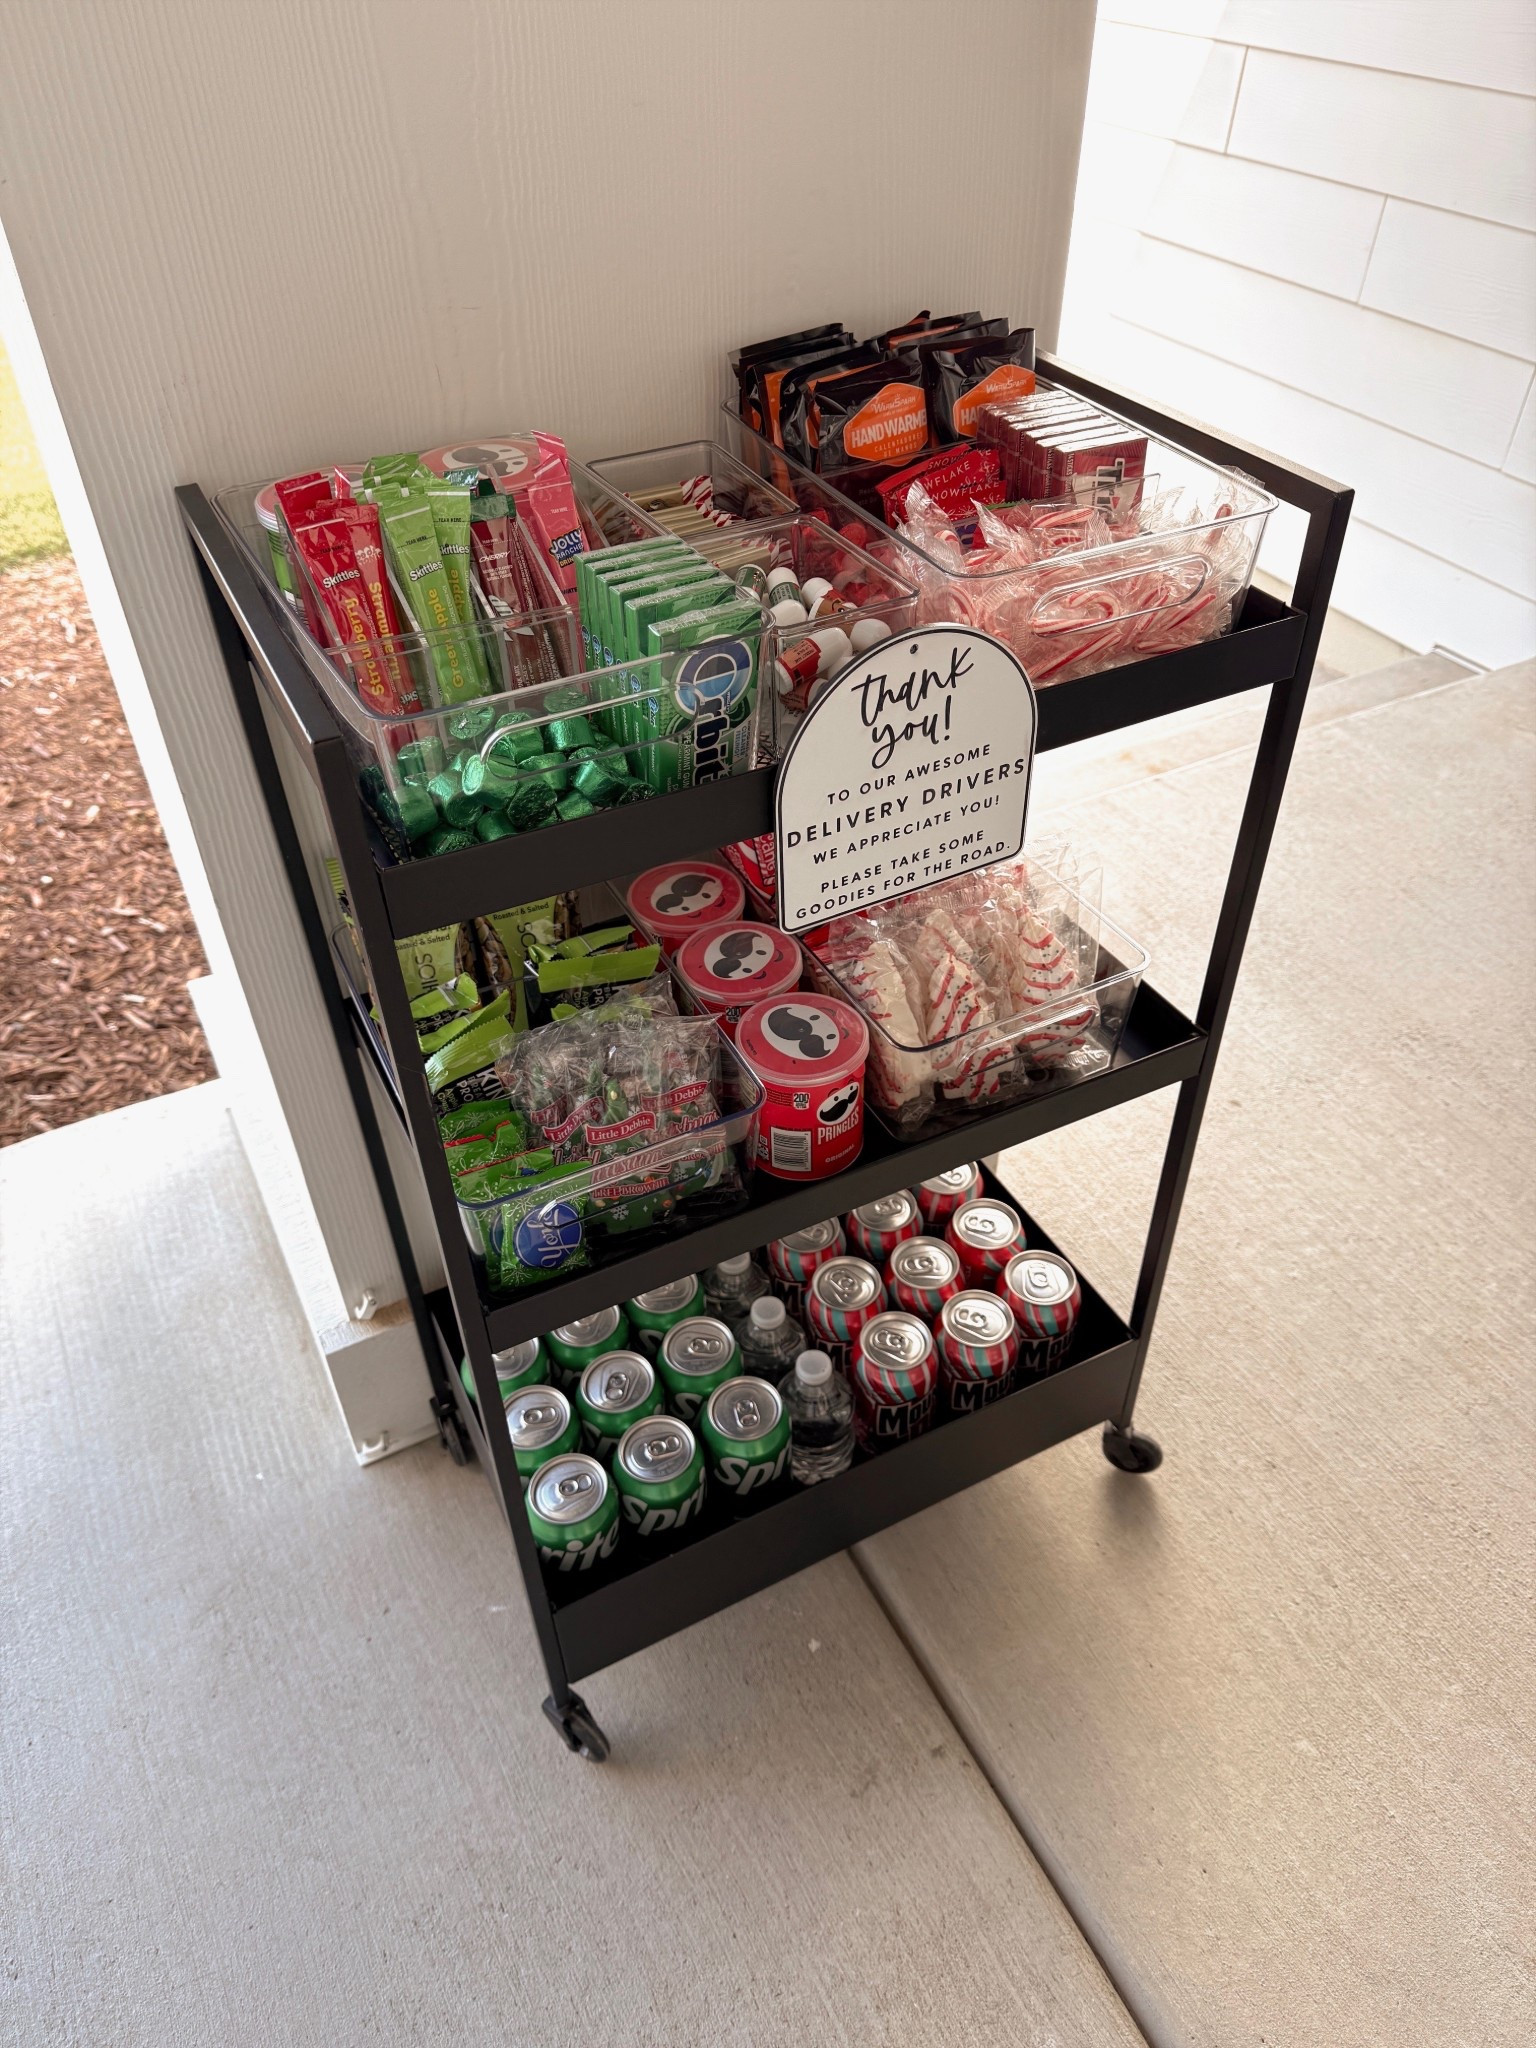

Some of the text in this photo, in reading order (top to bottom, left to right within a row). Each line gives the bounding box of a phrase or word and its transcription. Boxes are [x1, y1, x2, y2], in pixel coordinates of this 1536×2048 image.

[851, 426, 885, 449] HAND
[550, 528, 583, 554] JOLLY
[409, 560, 444, 583] Skittles
[559, 556, 574, 567] DRIN
[322, 568, 361, 589] Skittles
[851, 646, 974, 727] thank
[674, 633, 753, 787] Orbit
[871, 695, 952, 769] you!
[828, 744, 991, 805] TO OUR AWESOME
[787, 758, 1025, 849] DELIVERY DRIVERS
[813, 794, 1001, 865] WE APPRECIATE YOU!
[821, 829, 985, 893] PLEASE TAKE SOME
[796, 840, 1011, 920] GOODIES FOR THE ROAD.
[493, 909, 519, 921] Roasted
[526, 902, 550, 914] Salted
[394, 940, 418, 951] oasted
[428, 933, 451, 945] Salted
[793, 1092, 810, 1104] 200
[590, 1117, 652, 1142] Little Debbie
[816, 1107, 860, 1145] PRINGLES
[824, 1142, 856, 1164] ORIGINAL
